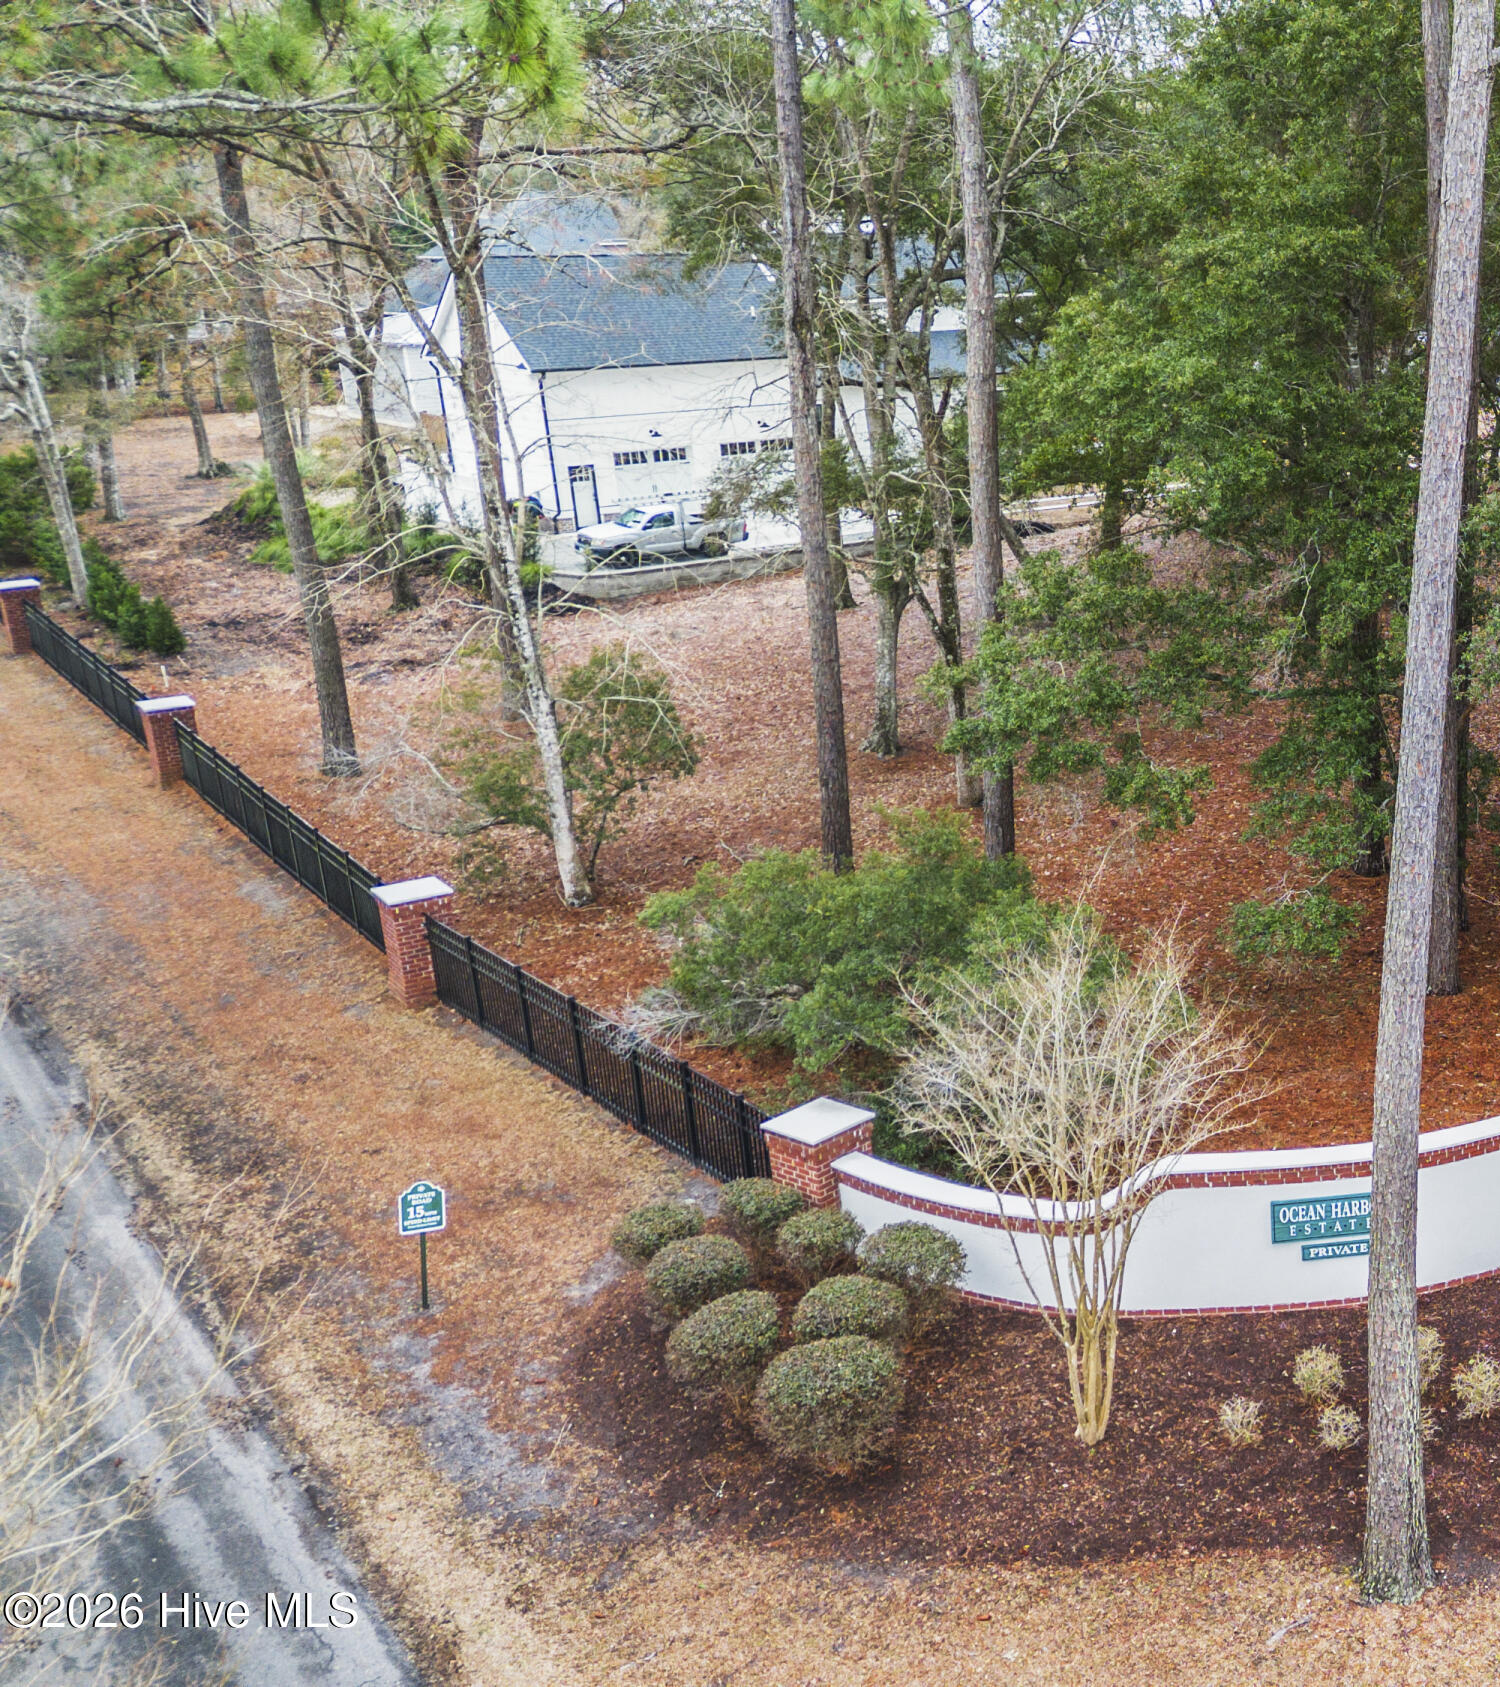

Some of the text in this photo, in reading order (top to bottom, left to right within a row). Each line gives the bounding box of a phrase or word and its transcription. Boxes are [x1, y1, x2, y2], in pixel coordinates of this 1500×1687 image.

[407, 1205, 424, 1219] 15
[1279, 1199, 1371, 1223] OCEAN HARB
[1309, 1243, 1368, 1258] PRIVATE
